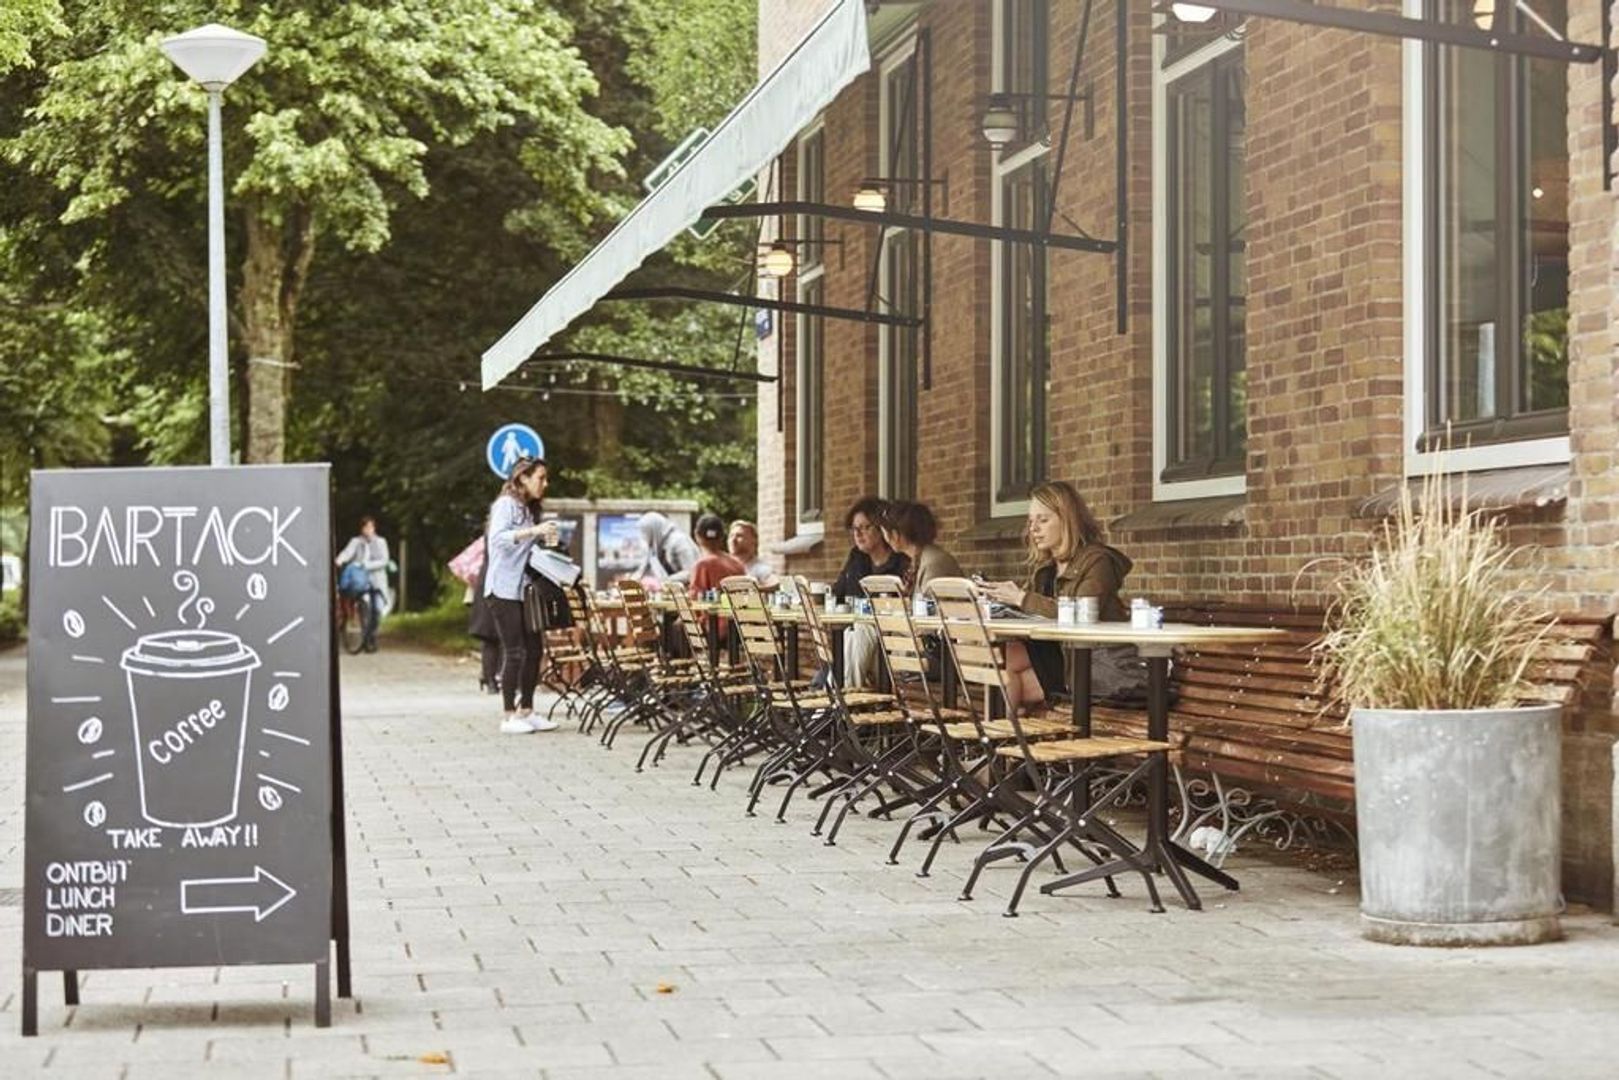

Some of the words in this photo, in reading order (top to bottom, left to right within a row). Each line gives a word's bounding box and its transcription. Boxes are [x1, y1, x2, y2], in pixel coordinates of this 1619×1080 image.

[50, 506, 307, 566] BARTACK
[149, 699, 226, 764] Coffee
[106, 828, 162, 849] TAKE
[181, 824, 258, 848] AWAY!!
[47, 886, 115, 910] LUNCH
[47, 912, 114, 937] DINER
